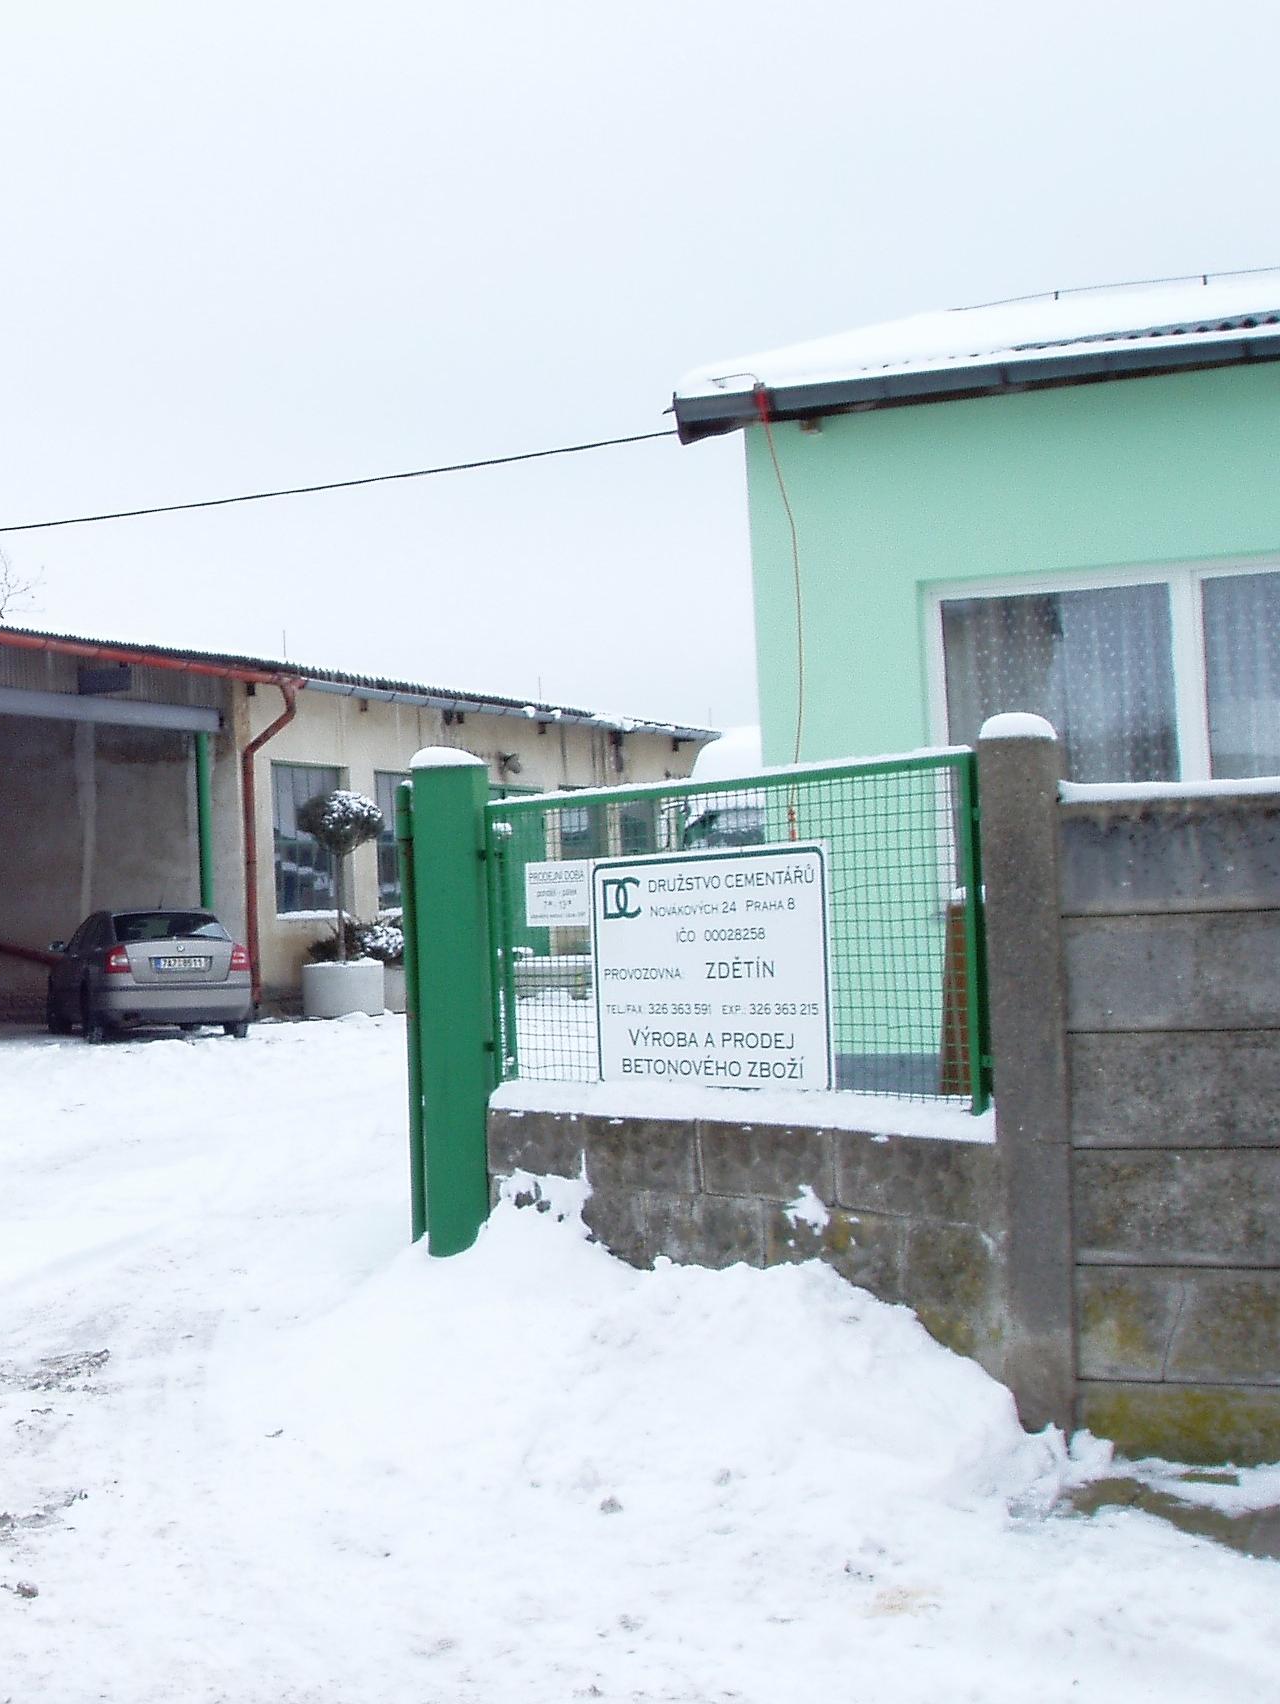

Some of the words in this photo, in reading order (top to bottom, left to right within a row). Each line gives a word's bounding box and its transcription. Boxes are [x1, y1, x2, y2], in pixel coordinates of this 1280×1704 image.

[648, 874, 721, 894] DRUŽSTVO
[724, 864, 815, 888] CEMENTÁŘŮ
[721, 901, 737, 914] 24
[787, 897, 796, 910] 8
[676, 927, 696, 943] IČO
[704, 927, 766, 942] 00028258
[705, 956, 775, 980] ZDĚTÍN
[648, 1003, 670, 1015] 326
[671, 1003, 692, 1015] 363
[694, 1003, 712, 1015] 591
[749, 1003, 771, 1015] 326
[775, 1003, 797, 1015] 363
[800, 1003, 819, 1015] 215
[628, 1026, 698, 1048] VÝROBA
[704, 1032, 715, 1048] A
[721, 1032, 795, 1050] PRODEJ
[622, 1055, 742, 1077] BETONOVÉHO
[747, 1056, 805, 1079] ZBOŽÍ
